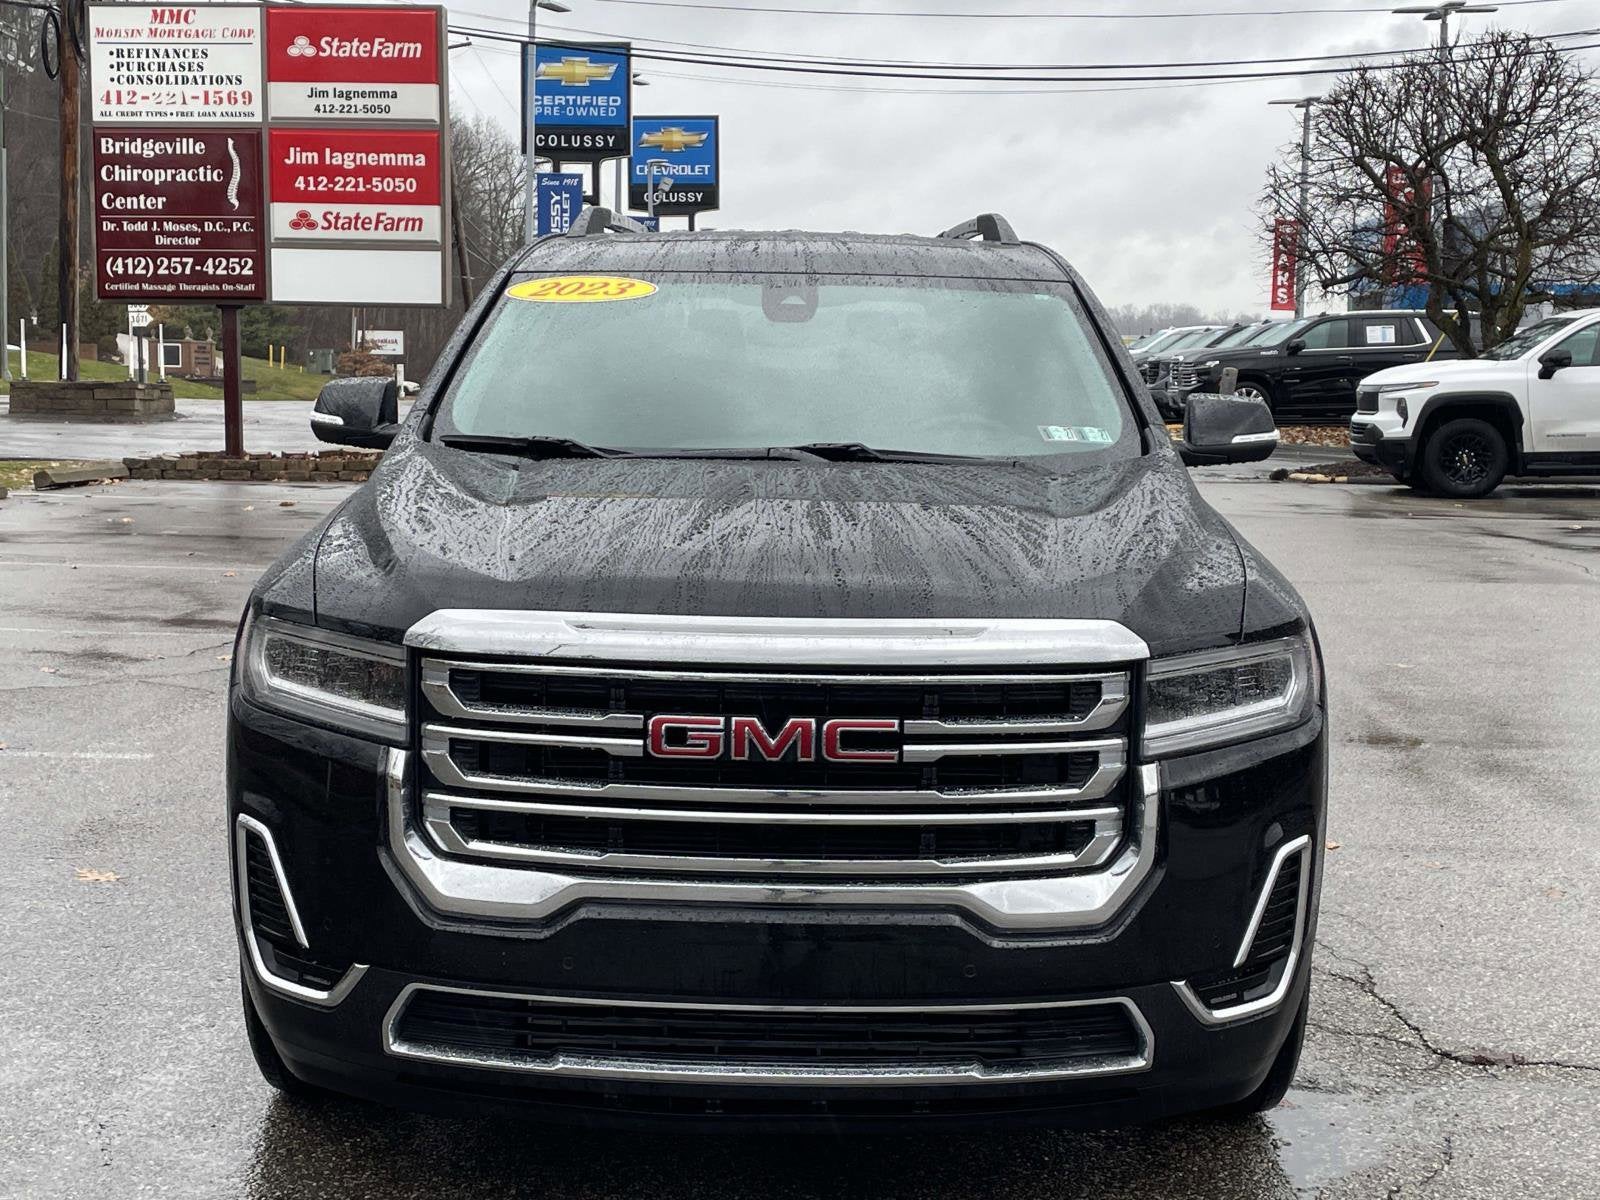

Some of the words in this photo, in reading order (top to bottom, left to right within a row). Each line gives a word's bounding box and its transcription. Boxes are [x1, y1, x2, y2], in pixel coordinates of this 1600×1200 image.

[150, 9, 196, 25] MMC
[147, 28, 216, 39] MORTGAGE
[100, 90, 253, 106] 412-221-1569
[307, 87, 329, 99] Jim
[333, 87, 398, 101] Iagnemma
[534, 95, 621, 106] CERTIFIED
[314, 104, 391, 114] 412-221-5050
[535, 106, 617, 117] PRE-OWNED
[535, 134, 616, 147] COLUSSY
[100, 137, 206, 158] Bridgeville
[284, 147, 319, 165] Jim
[324, 148, 426, 169] Iagnemma
[100, 164, 224, 185] Chiropractic
[636, 164, 711, 176] CHEVROLET
[294, 176, 417, 193] 412-221-5050
[541, 177, 560, 186] Since
[562, 178, 579, 186] 1918
[101, 192, 167, 210] Center
[643, 192, 703, 203] COLUSSY
[102, 221, 119, 232] Dr.
[122, 221, 148, 232] Todd
[151, 221, 160, 232] J.
[163, 221, 202, 233] Moses,
[204, 221, 231, 233] D.C.,
[232, 221, 254, 232] P.C.
[321, 211, 423, 232] StateFarm
[155, 235, 201, 245] Director
[141, 283, 176, 292] Massage
[179, 283, 220, 292] Therapists
[222, 283, 255, 291] On-Staff
[529, 281, 636, 297] 2023
[647, 714, 900, 763] GMC
